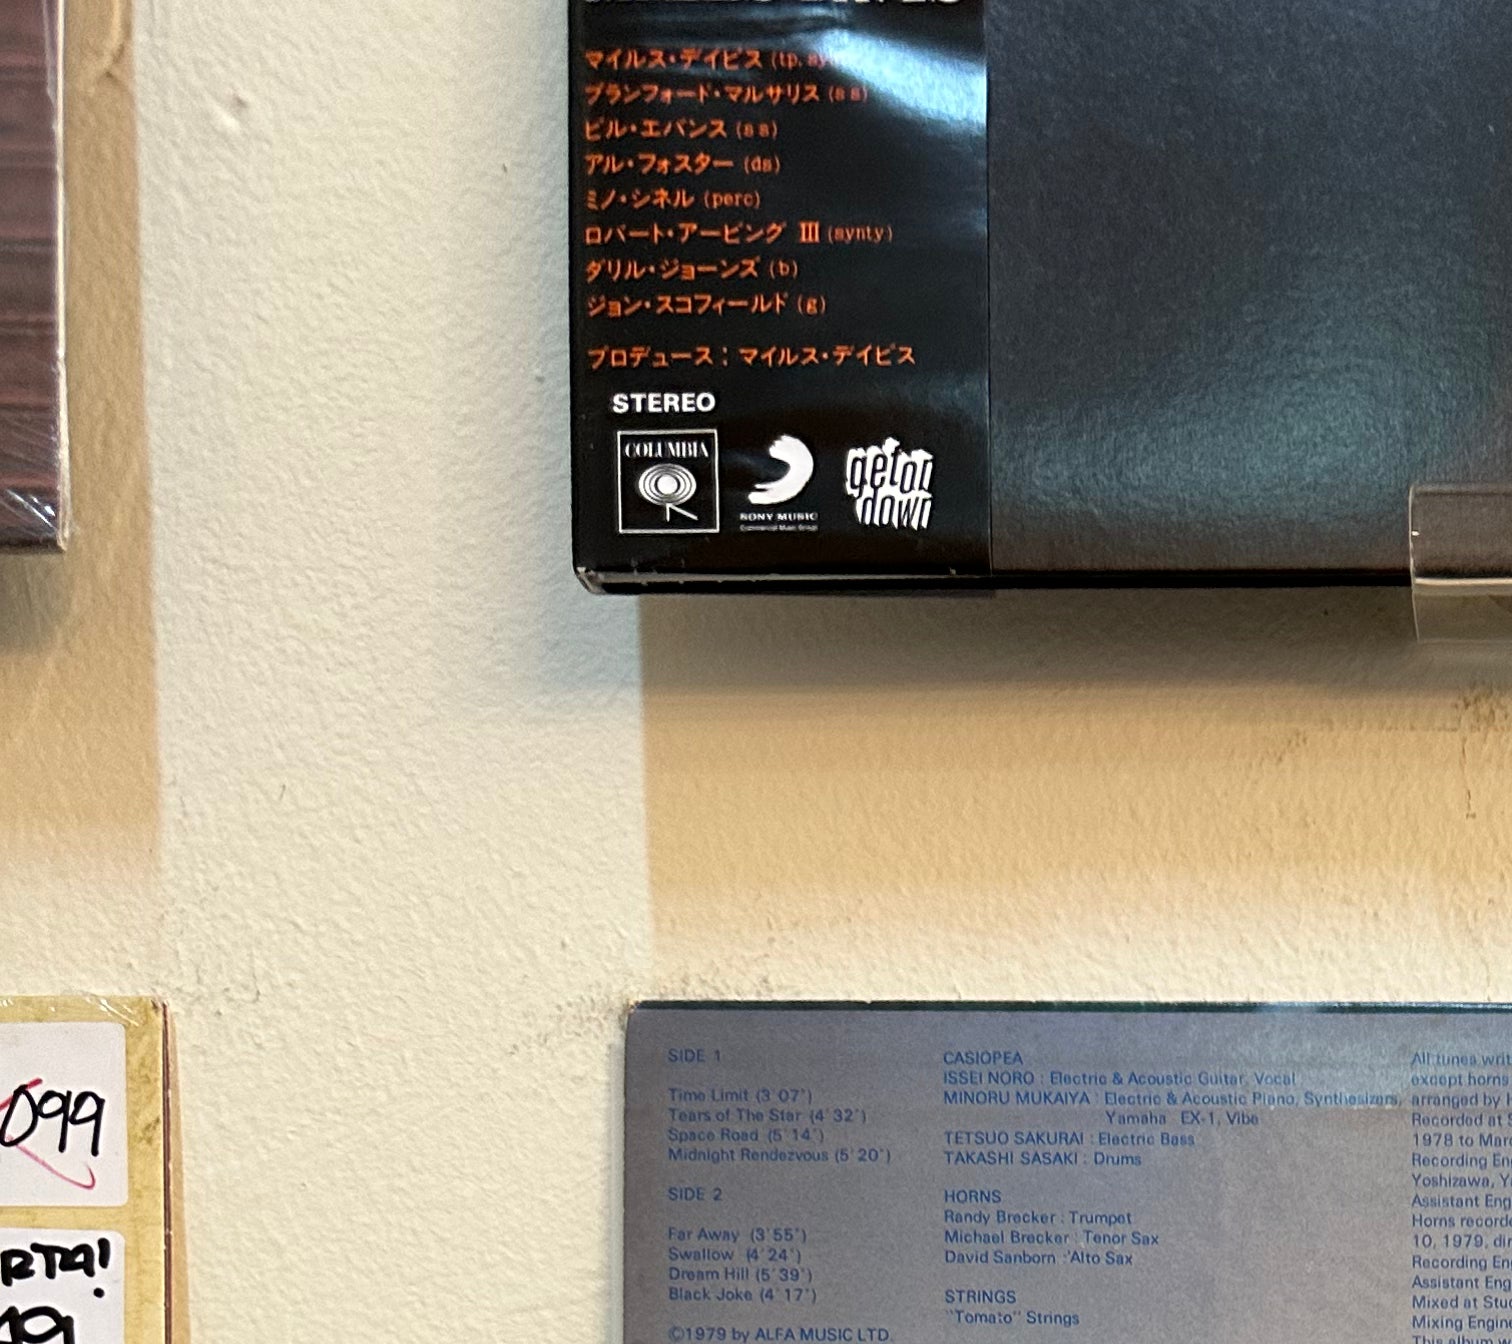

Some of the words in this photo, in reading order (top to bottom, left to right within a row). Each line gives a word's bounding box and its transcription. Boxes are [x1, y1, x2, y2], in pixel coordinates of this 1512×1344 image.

[612, 392, 716, 414] STEREO
[625, 439, 709, 459] COLUMBIA
[668, 1049, 705, 1062] SIDE
[714, 1050, 721, 1061] 1
[944, 1052, 1023, 1065] CASIOPEA
[944, 1072, 982, 1084] ISSEI
[988, 1072, 1034, 1085] NORO
[668, 1089, 705, 1102] Time
[711, 1089, 749, 1102] Limit
[944, 1091, 1010, 1104] MINORU
[1016, 1092, 1090, 1105] MUKAIYA
[669, 1109, 711, 1122] Tears
[716, 1109, 730, 1122] of
[737, 1109, 763, 1122] The
[769, 1109, 802, 1122] Star
[668, 1129, 715, 1143] Space
[721, 1128, 758, 1142] Road
[945, 1132, 1008, 1145] TETSUO
[1014, 1132, 1084, 1145] SAKURAI
[668, 1148, 735, 1164] Midnight
[741, 1149, 828, 1162] Rendezvous
[945, 1152, 1013, 1165] TAKASHI
[1020, 1152, 1077, 1165] SASAKI
[668, 1188, 705, 1201] SIDE
[713, 1188, 722, 1201] 2
[944, 1190, 1001, 1203] HORNS
[668, 1228, 691, 1240] Far
[697, 1228, 740, 1243] Away
[945, 1231, 1004, 1244] Michael
[1010, 1231, 1069, 1244] Brecker
[668, 1248, 734, 1261] Swallow
[945, 1251, 988, 1264] David
[993, 1251, 1056, 1264] Sanborn
[669, 1267, 719, 1281] Dream
[724, 1267, 749, 1281] Hill
[669, 1288, 710, 1301] Black
[717, 1288, 752, 1301] Joke
[945, 1291, 1016, 1303] STRINGS
[1026, 1311, 1080, 1327] Strings
[732, 1328, 750, 1343] by
[755, 1328, 795, 1341] ALFA
[800, 1328, 853, 1341] MUSIC
